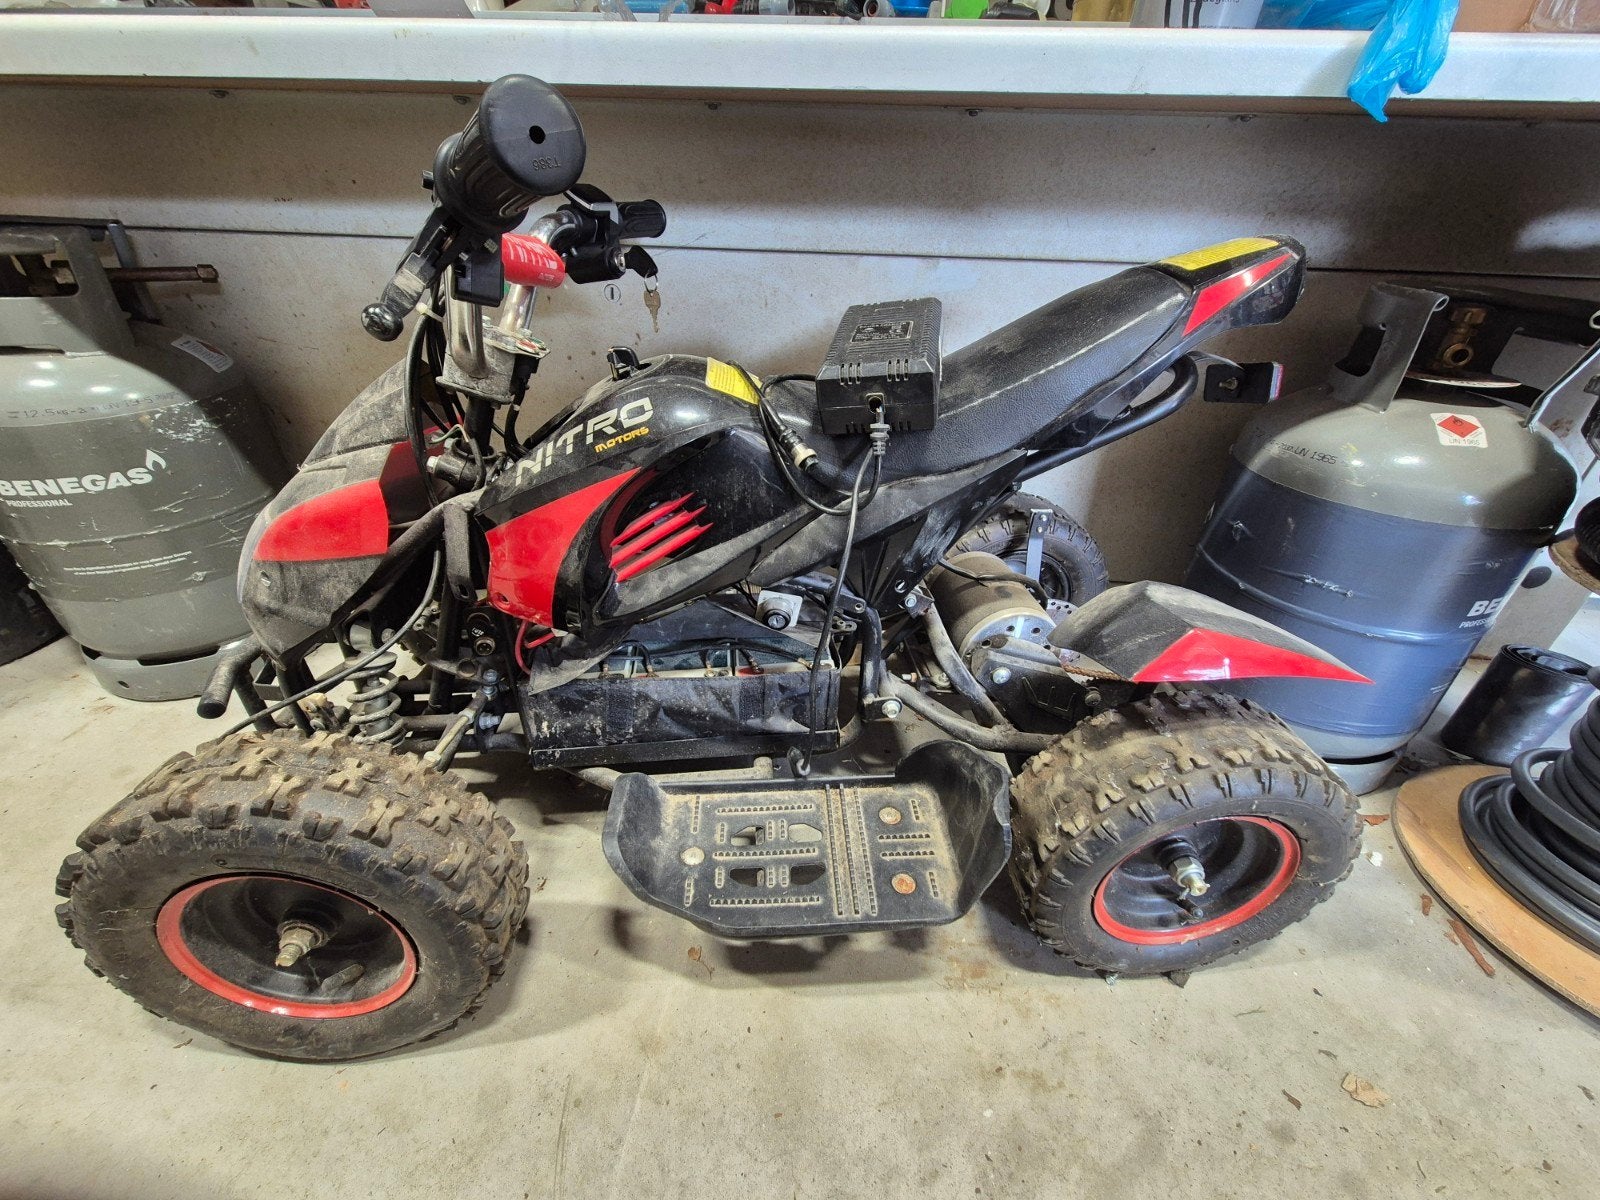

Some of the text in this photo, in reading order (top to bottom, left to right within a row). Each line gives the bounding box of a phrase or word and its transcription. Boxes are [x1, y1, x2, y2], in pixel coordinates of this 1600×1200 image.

[515, 397, 653, 486] NITRO
[594, 426, 650, 453] MOTORS
[1310, 451, 1338, 465] 1965
[0, 467, 153, 496] BENEGAS
[6, 499, 73, 508] PROFESSIONAL
